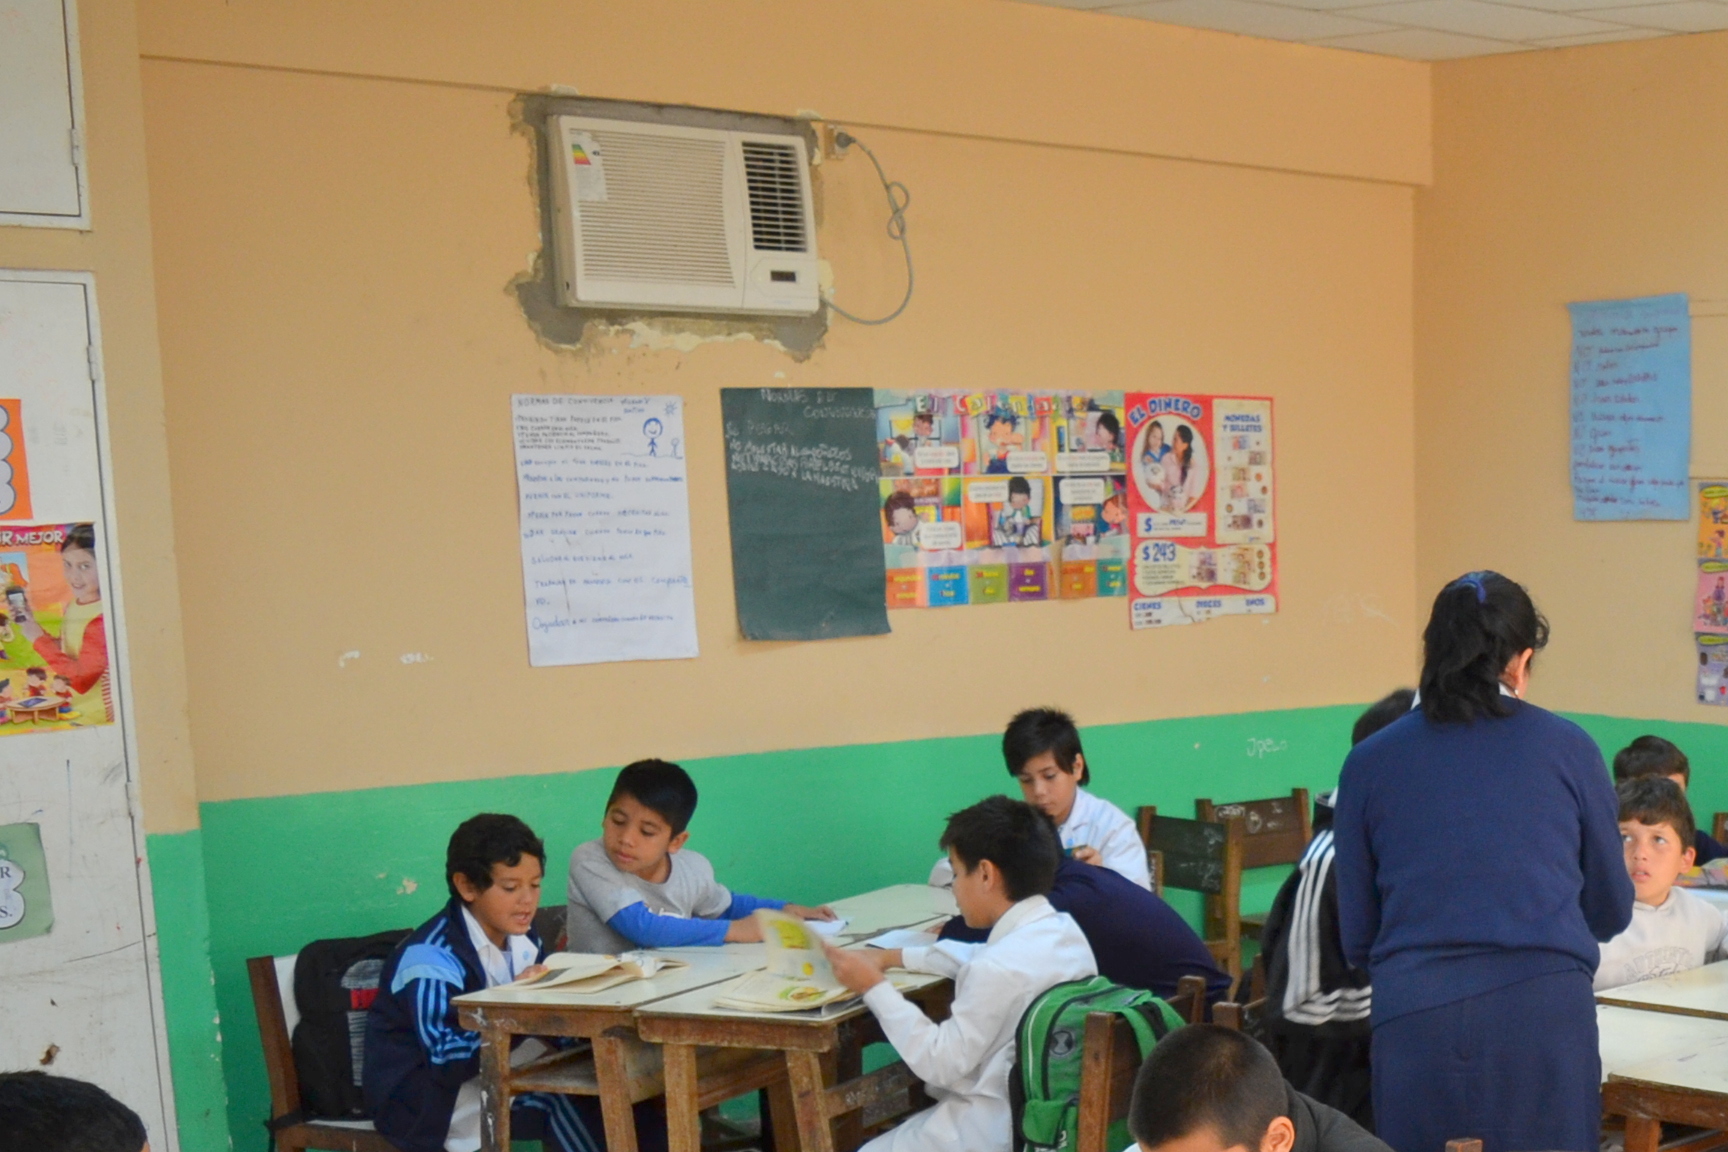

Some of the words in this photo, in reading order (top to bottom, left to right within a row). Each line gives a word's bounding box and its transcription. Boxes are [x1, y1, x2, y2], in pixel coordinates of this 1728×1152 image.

[1128, 405, 1147, 427] EL
[1147, 396, 1203, 419] DINERO
[15, 530, 65, 546] MEJOR
